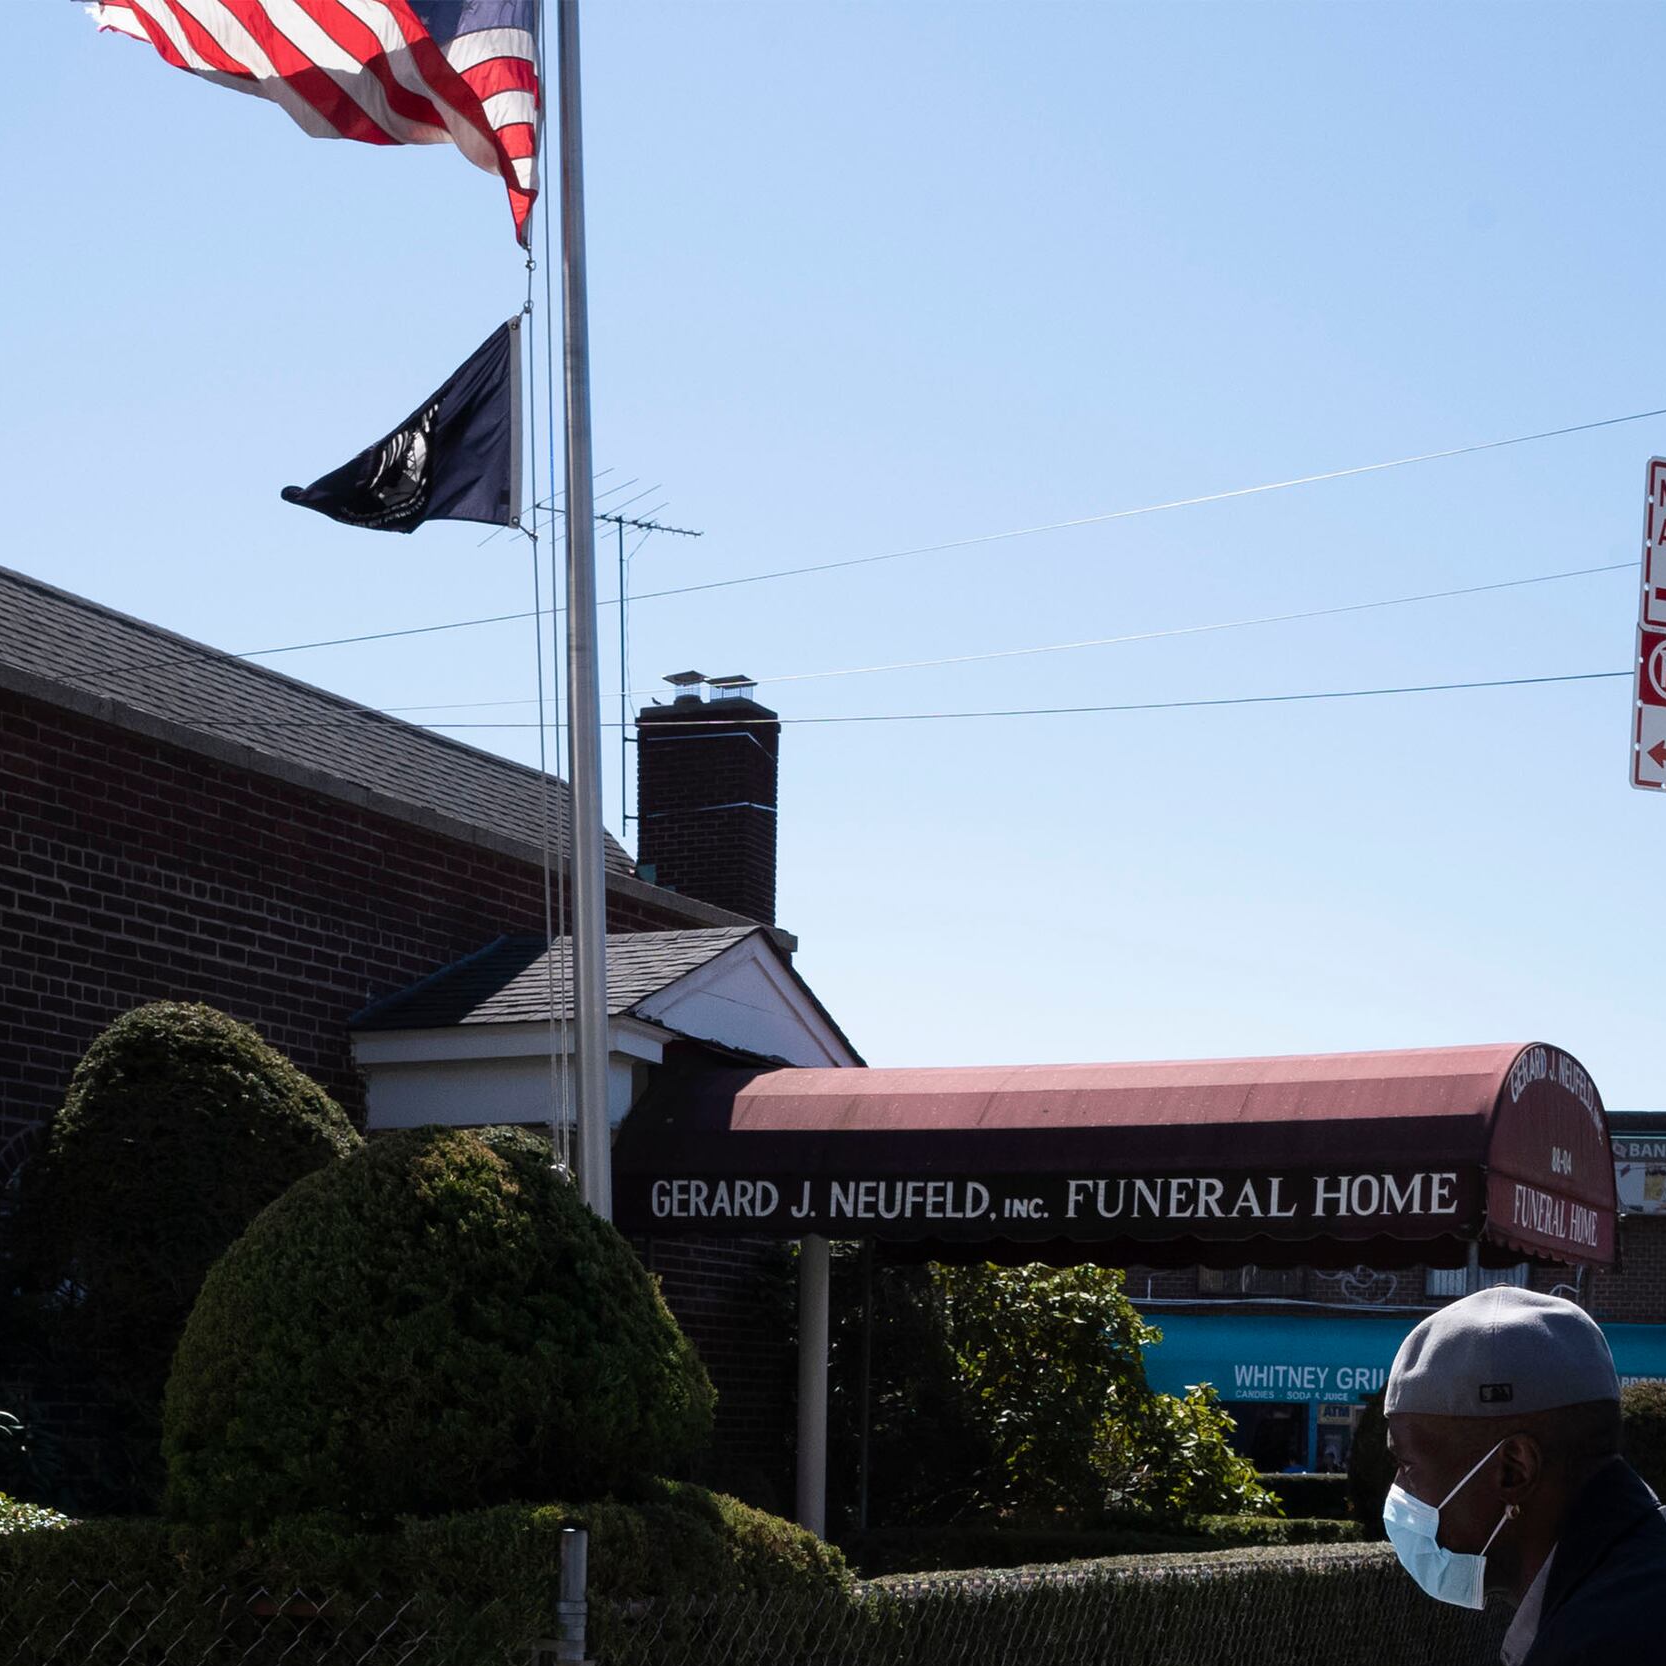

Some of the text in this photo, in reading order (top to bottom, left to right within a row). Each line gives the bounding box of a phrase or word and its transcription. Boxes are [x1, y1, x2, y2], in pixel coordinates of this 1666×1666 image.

[1511, 1047, 1547, 1104] GERARD
[1549, 1050, 1558, 1082] J.
[651, 1172, 1459, 1221] GERARD J. NEUFELD, INC. FUNERAL HOME
[1513, 1184, 1598, 1247] FUNERAL HOME
[1234, 1364, 1329, 1389] WHITNEY
[1235, 1389, 1275, 1399] CANDIES
[1286, 1390, 1311, 1401] SODA
[1323, 1391, 1349, 1402] JUICE
